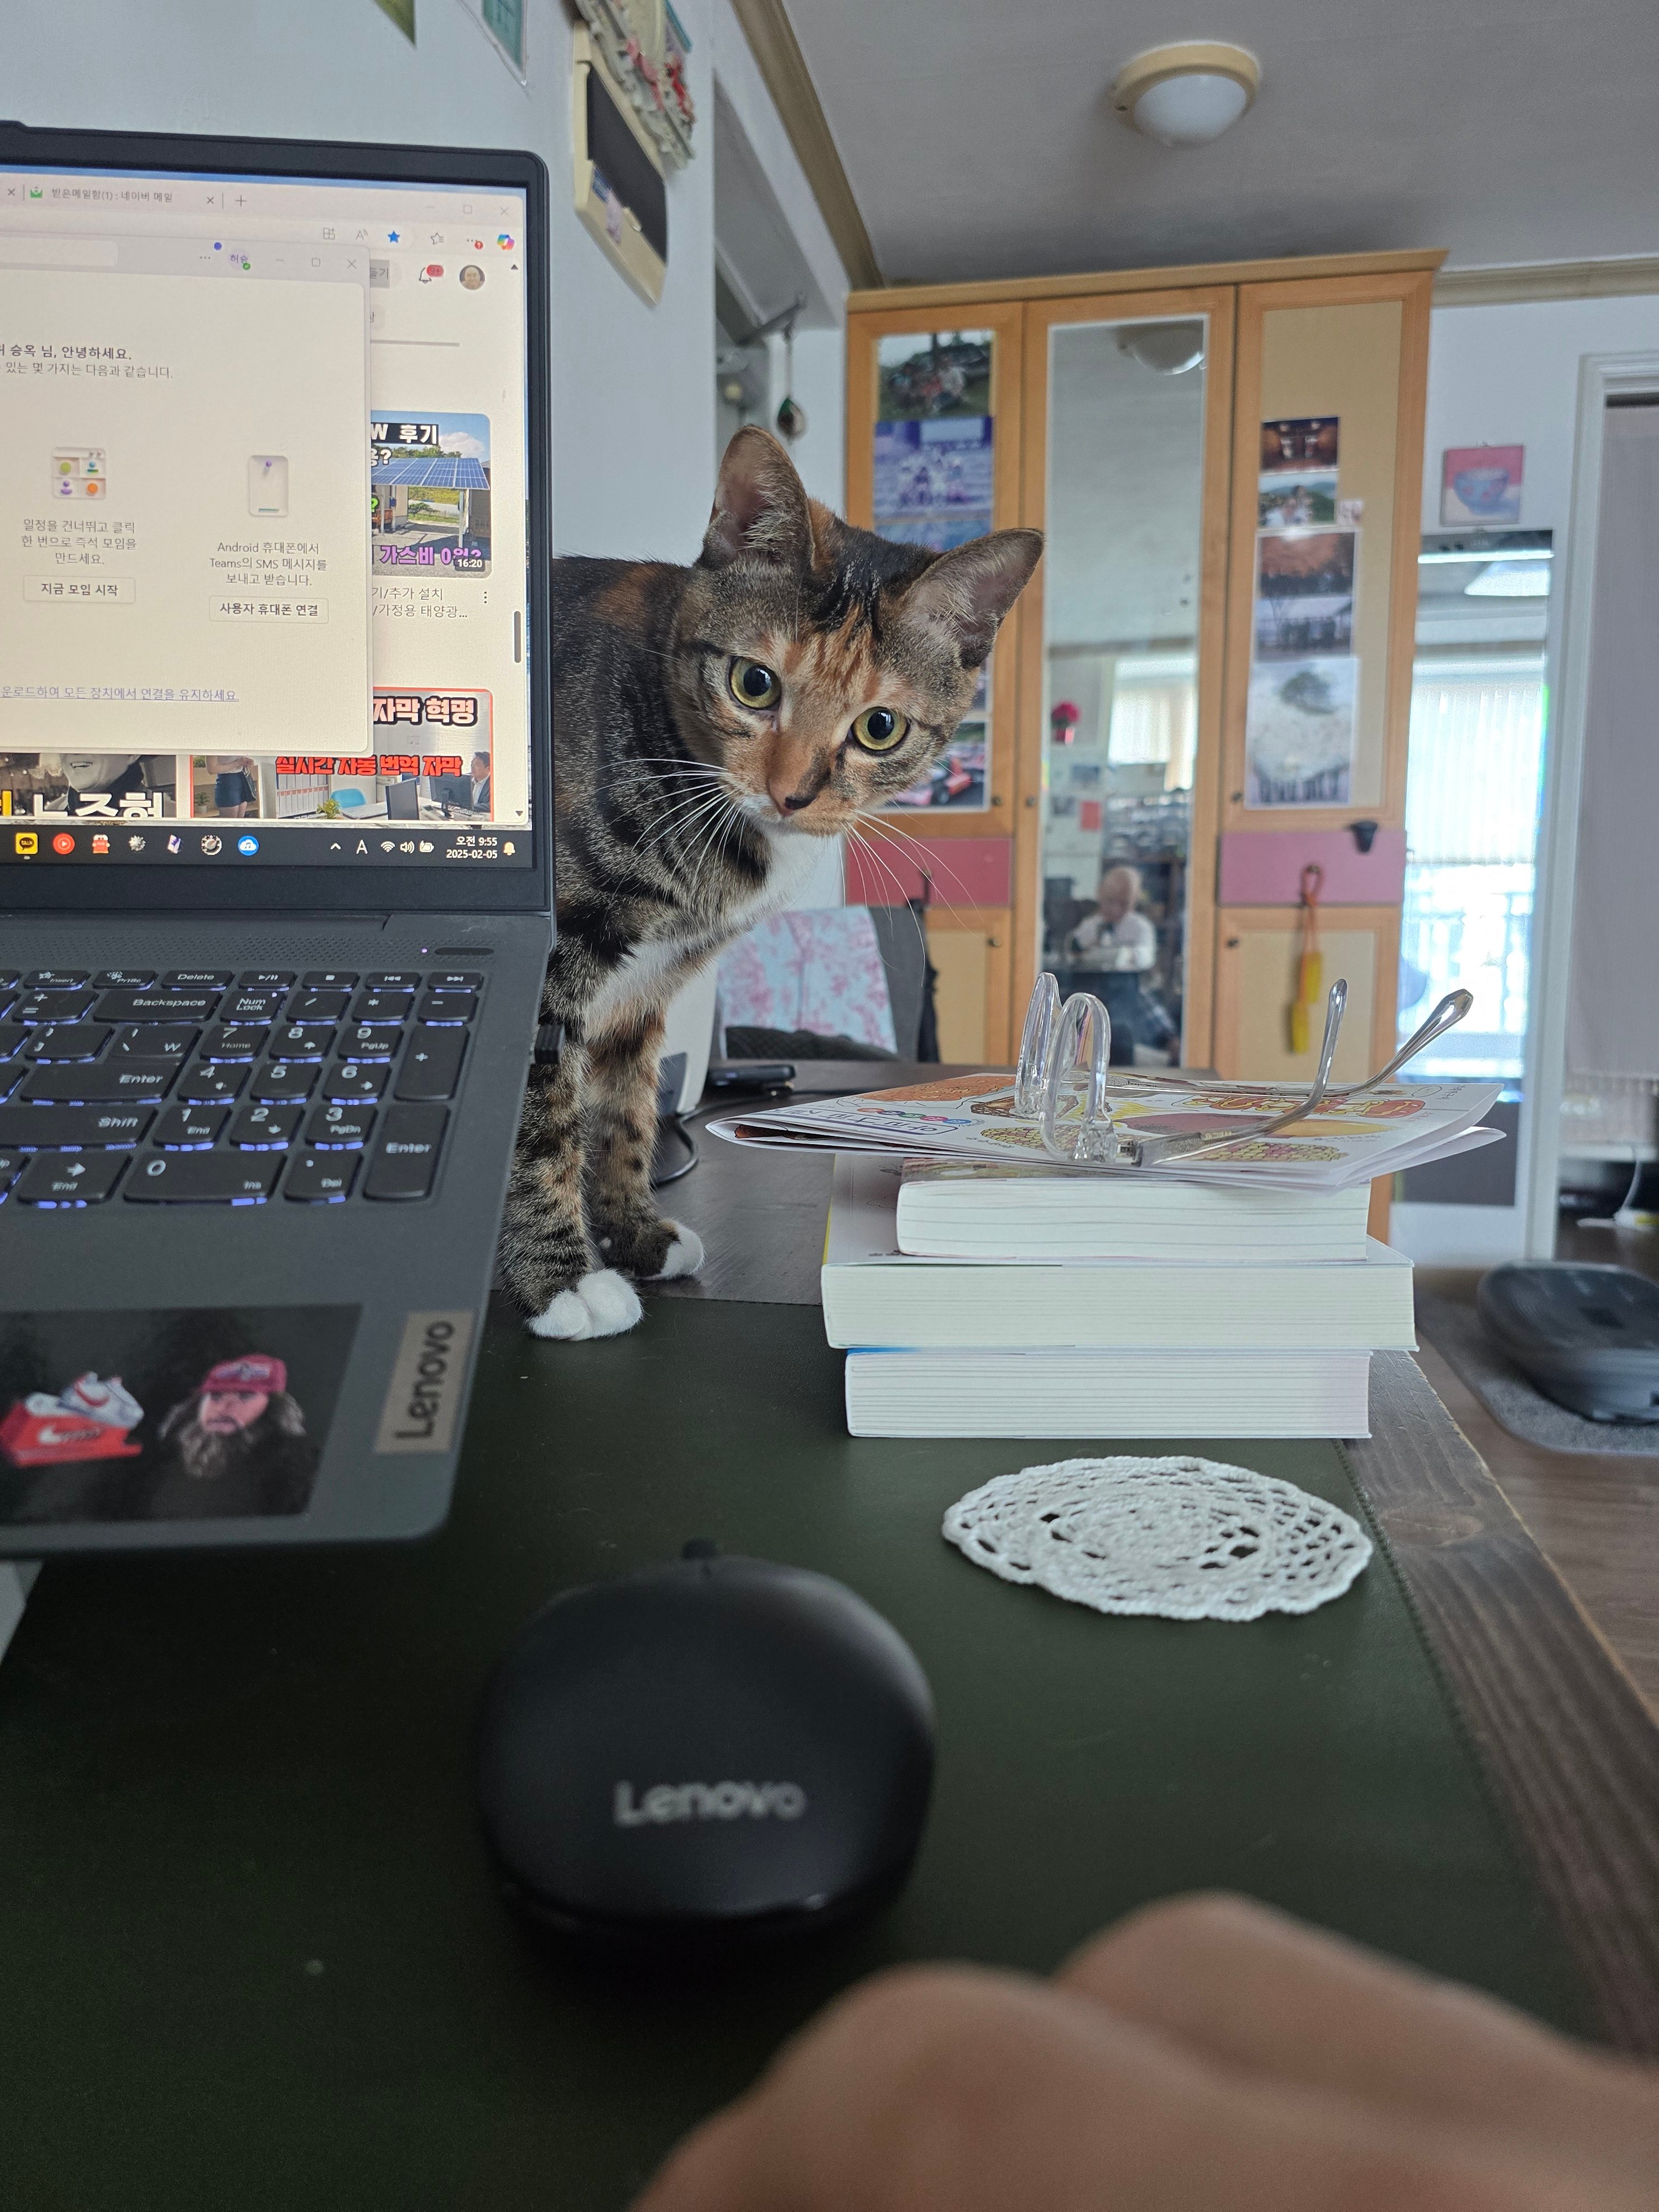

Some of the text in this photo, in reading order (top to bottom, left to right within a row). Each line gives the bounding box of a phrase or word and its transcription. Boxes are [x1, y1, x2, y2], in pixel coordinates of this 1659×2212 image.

[52, 188, 113, 201] 받은메일함(1)
[121, 191, 150, 201] 네이버
[154, 192, 173, 202] 메일
[9, 345, 36, 357] 승옥
[41, 345, 56, 358] 님,
[62, 346, 132, 360] 안녕하세요.
[6, 362, 173, 379] 있는 몇 가지는 다음과 같습니다.
[399, 424, 437, 444] 후기
[24, 519, 135, 534] 일정을 건너뛰고 클릭
[22, 535, 137, 550] 한 번으로 즉석 모임을
[217, 542, 319, 555] Android 휴대폰에서
[55, 552, 105, 565] 만드세요.
[380, 545, 434, 565] 가스비
[209, 557, 327, 571] Teams의 SMS 메시지를
[457, 559, 482, 567] 16:20
[226, 573, 312, 586] 보내고 받습니다.
[41, 583, 118, 597] 지금 모임 시작
[419, 588, 443, 601] 설치
[220, 603, 318, 616] 사용자 휴대폰 연결
[65, 687, 87, 699] 모든
[90, 687, 137, 700] 장치에서
[141, 688, 175, 701] 연결을
[180, 689, 239, 701] 유지하세요.
[373, 697, 475, 724] 자막 혁명
[337, 757, 377, 776] 자동
[380, 755, 420, 776] 번역
[422, 755, 463, 777] 자막
[356, 840, 368, 854] A
[456, 836, 497, 847] 오전 9:55
[446, 849, 498, 859] 2025-02-05
[133, 998, 206, 1008] Backspace
[223, 1027, 237, 1039] 7
[288, 1027, 304, 1039] 8
[357, 1027, 372, 1039] 9
[200, 1066, 216, 1078] 4
[270, 1065, 287, 1078] 5
[341, 1065, 358, 1078] 6
[119, 1074, 163, 1084] Enter
[181, 1108, 192, 1122] 1
[251, 1108, 269, 1122] 2
[325, 1107, 343, 1121] 3
[98, 1116, 139, 1128] Shift
[187, 1126, 211, 1135] End
[386, 1142, 432, 1154] Enter
[52, 1181, 78, 1191] End
[392, 1321, 455, 1439] Lenovo
[614, 1779, 807, 1828] Lenovo
